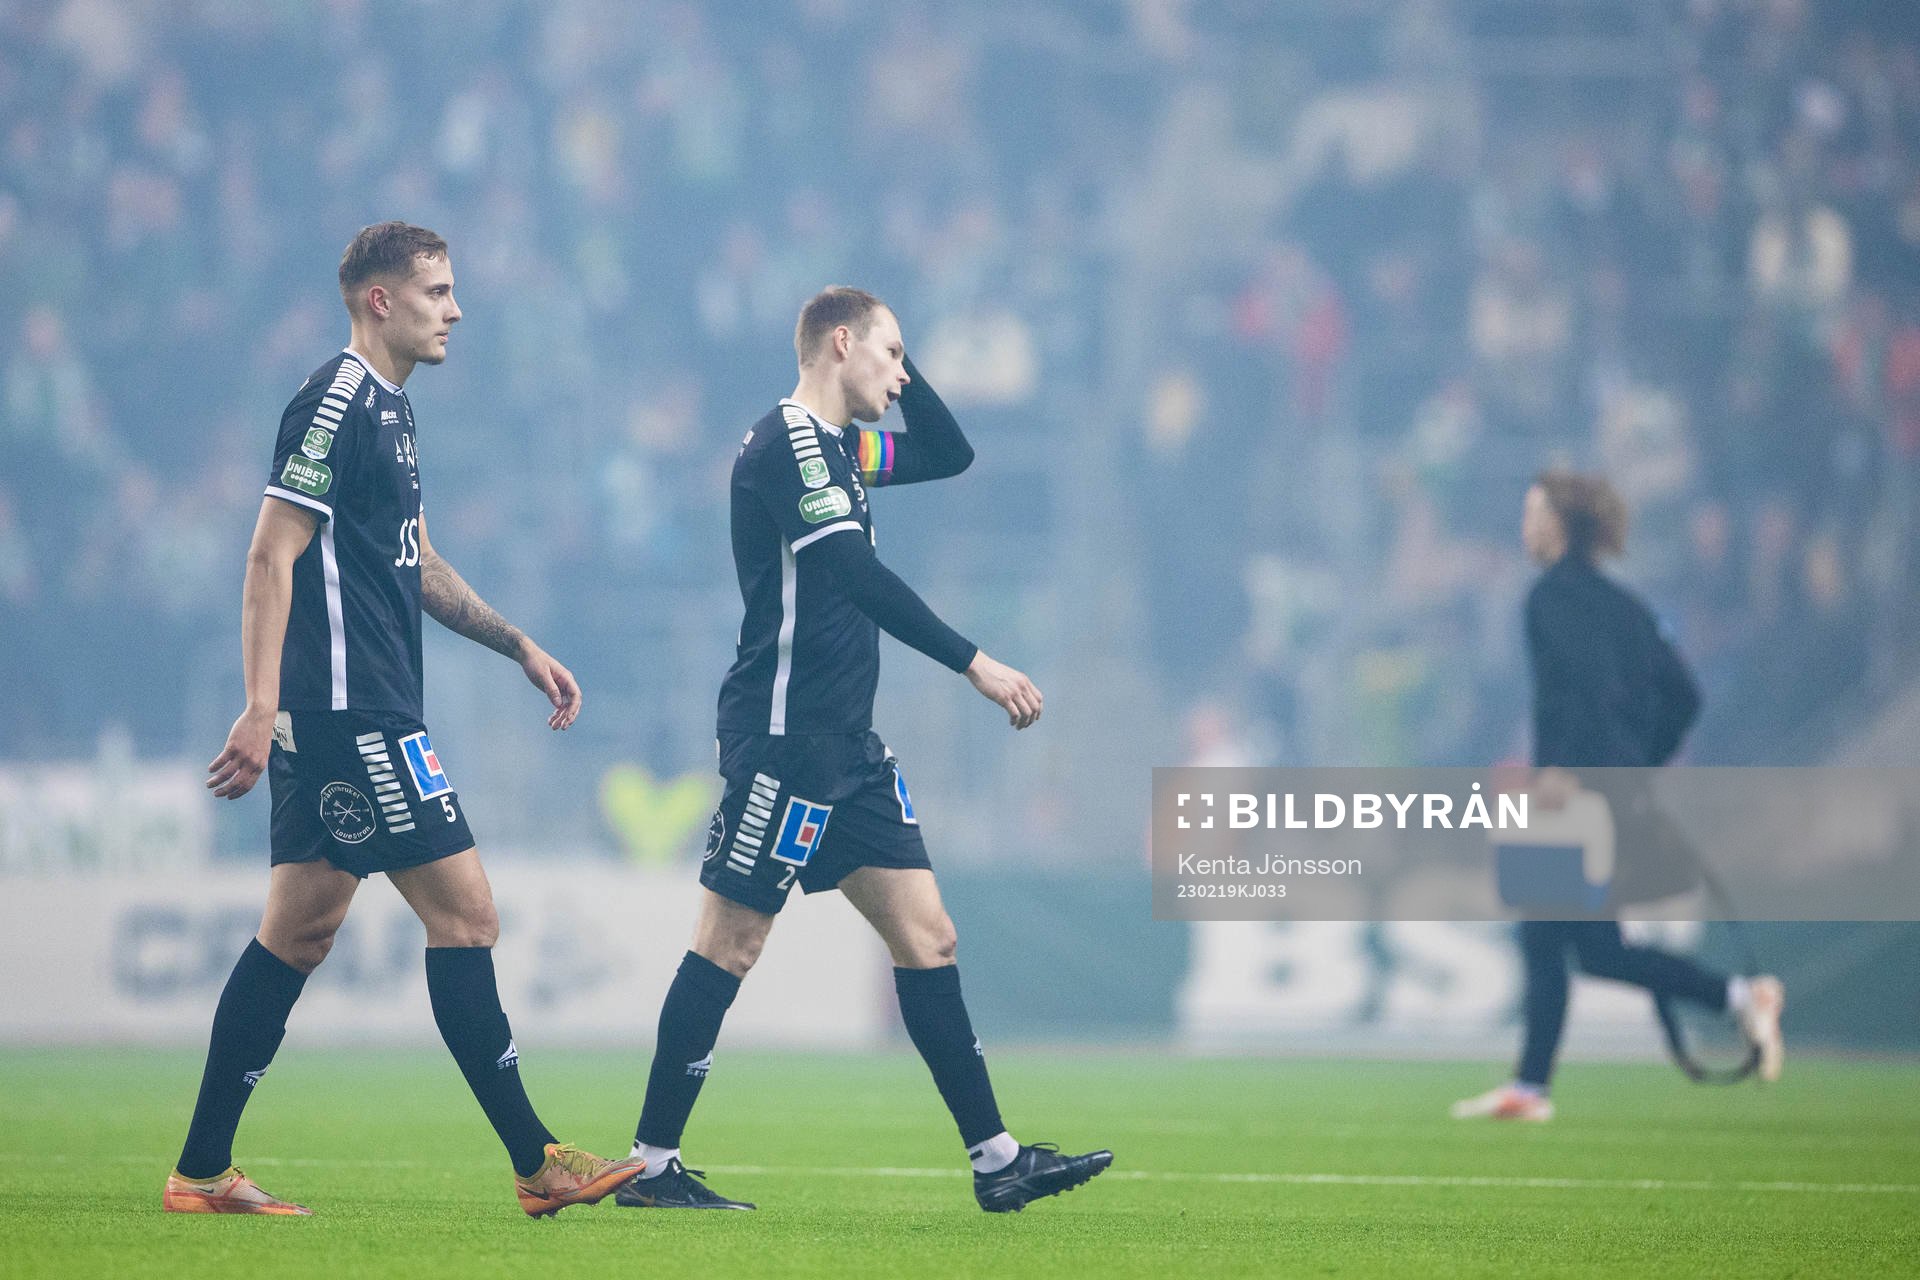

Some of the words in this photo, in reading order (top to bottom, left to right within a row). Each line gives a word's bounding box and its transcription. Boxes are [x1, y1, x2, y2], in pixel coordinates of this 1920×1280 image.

[287, 463, 328, 483] UNIBET
[440, 795, 456, 823] 5
[776, 866, 796, 890] 2
